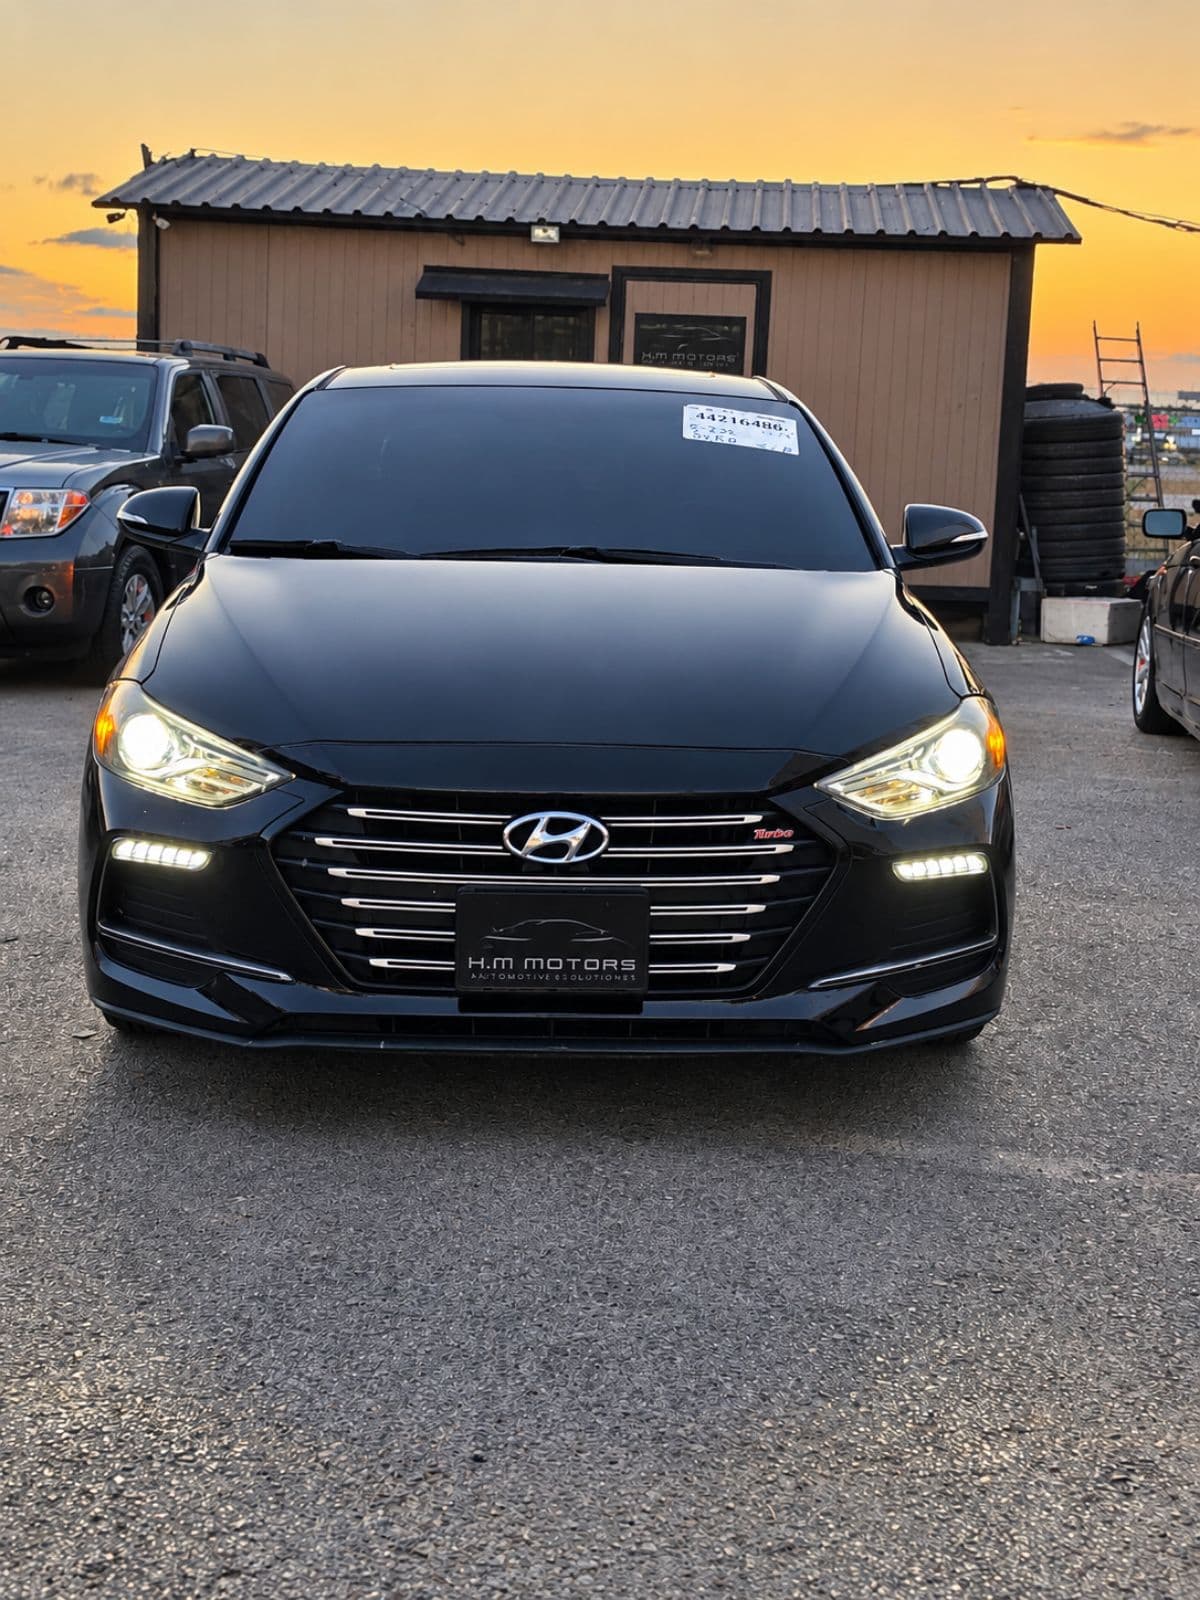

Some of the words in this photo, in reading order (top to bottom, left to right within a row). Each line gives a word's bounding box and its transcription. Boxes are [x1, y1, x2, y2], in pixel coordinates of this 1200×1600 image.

[672, 353, 737, 363] MOTORS
[753, 828, 794, 840] Turbo
[468, 957, 513, 969] H.M
[524, 958, 636, 971] MOTORS
